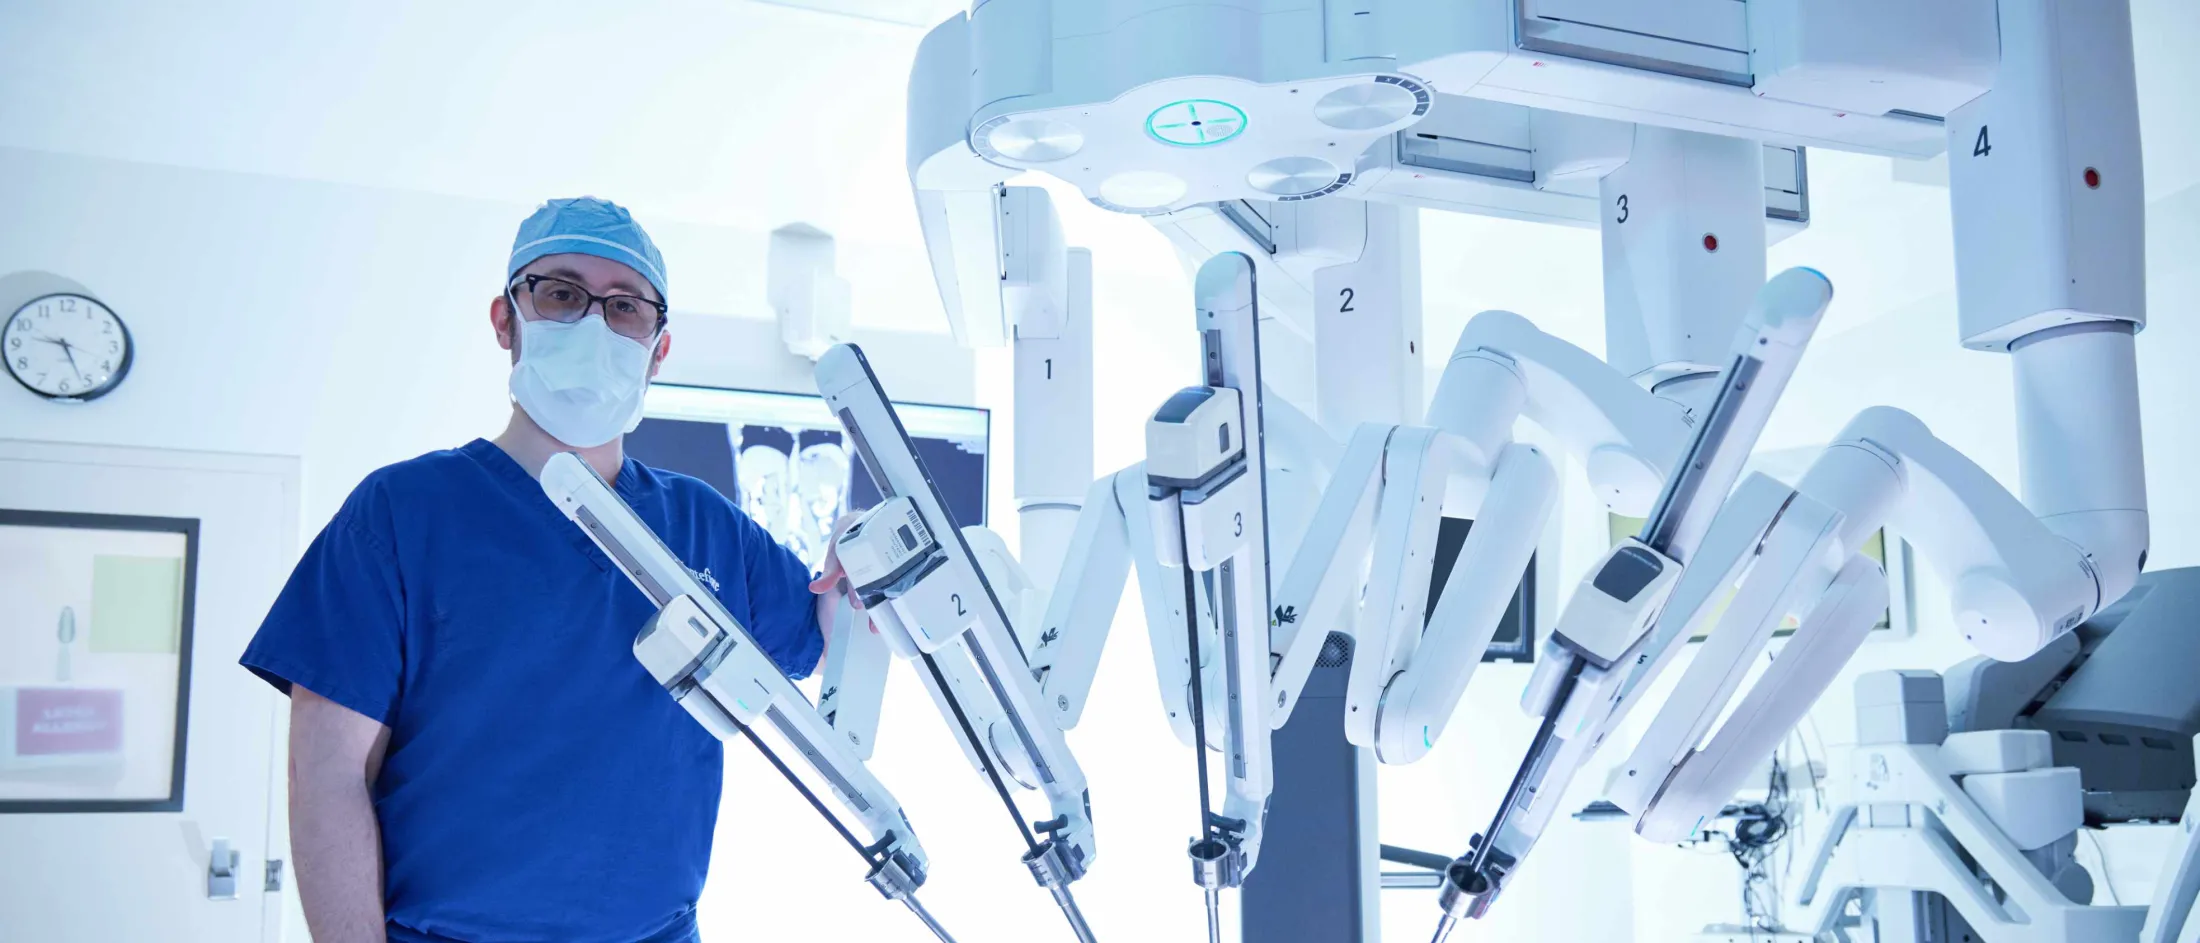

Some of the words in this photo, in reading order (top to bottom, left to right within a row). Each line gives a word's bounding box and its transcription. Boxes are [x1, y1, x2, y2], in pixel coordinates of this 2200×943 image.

[1973, 124, 1992, 157] 4
[1616, 194, 1629, 224] 3
[60, 299, 76, 313] 12
[1340, 287, 1354, 312] 2
[38, 304, 50, 318] 11
[86, 305, 93, 319] 1
[16, 318, 32, 331] 10
[102, 320, 112, 334] 2
[11, 337, 21, 351] 9
[109, 340, 118, 354] 3
[17, 357, 28, 370] 8
[101, 360, 110, 373] 4
[1044, 358, 1051, 380] 1
[36, 371, 47, 386] 7
[59, 379, 69, 392] 6
[83, 374, 92, 388] 5
[1234, 511, 1242, 537] 3
[951, 593, 966, 616] 2
[753, 677, 770, 694] 1
